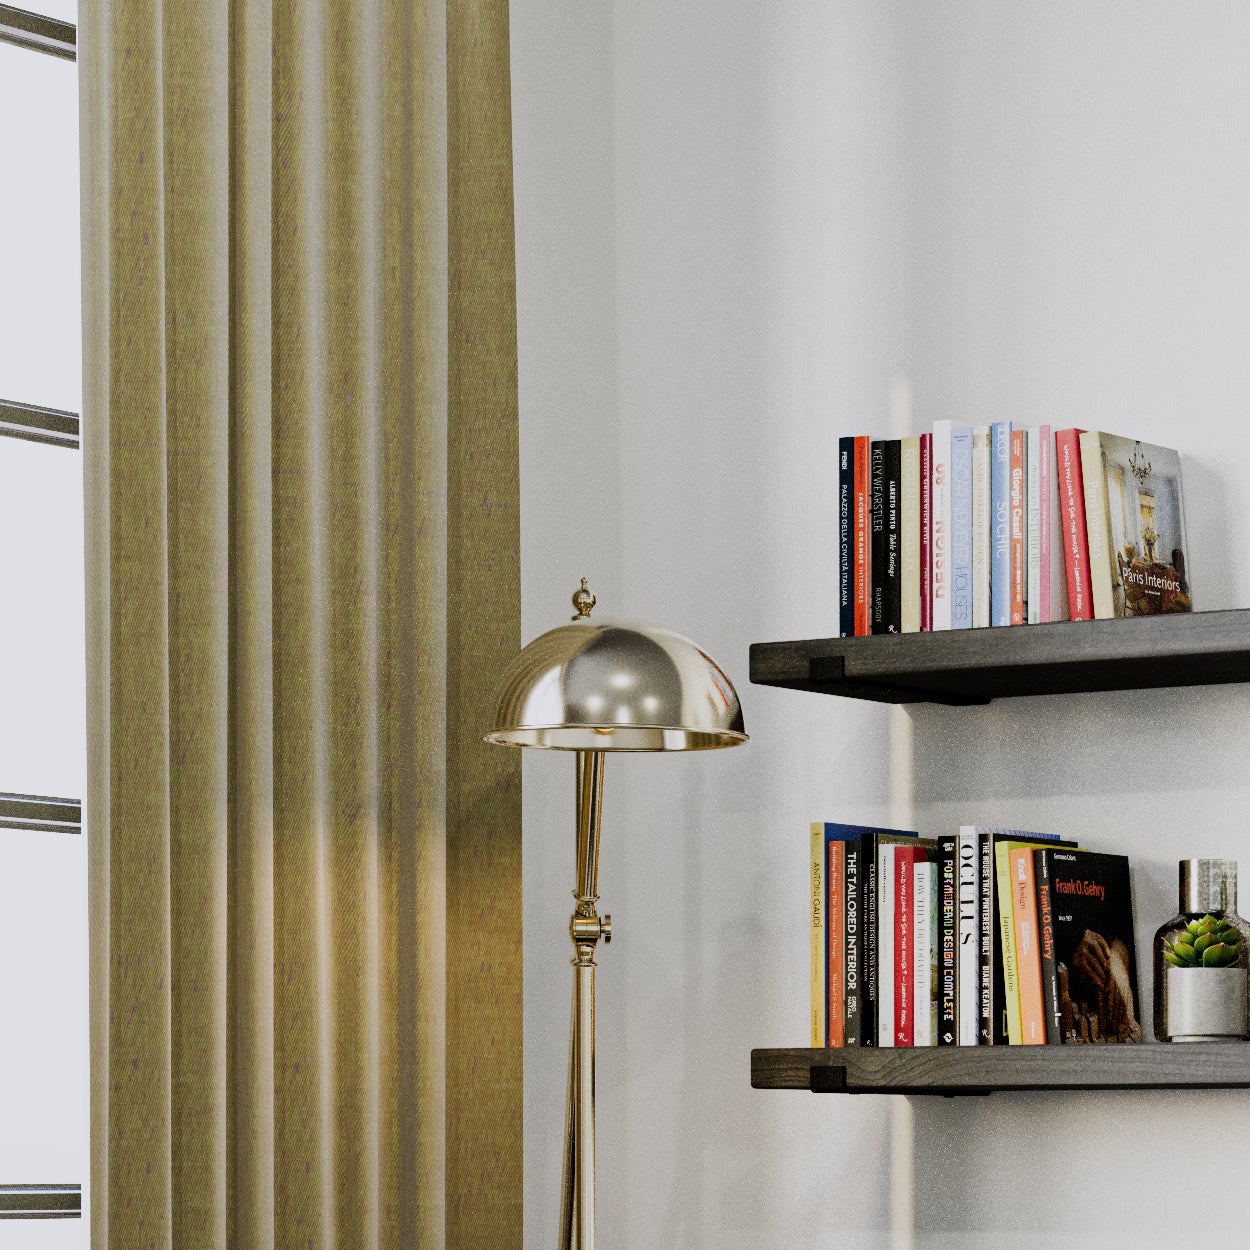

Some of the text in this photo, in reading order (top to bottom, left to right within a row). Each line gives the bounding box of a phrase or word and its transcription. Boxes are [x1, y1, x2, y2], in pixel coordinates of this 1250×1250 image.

[873, 449, 882, 532] KELLY WEARSTLER
[905, 448, 915, 517] REGENCY
[954, 447, 968, 497] OSCAR
[1011, 468, 1023, 506] Giorgio
[1063, 444, 1071, 468] WOULD
[1068, 497, 1074, 506] TO
[954, 500, 968, 565] NIEMEYER
[997, 501, 1009, 559] SO CHIC
[1012, 508, 1023, 539] Casali
[1088, 480, 1103, 559] Paris Interiors
[841, 543, 849, 571] CIVILTÀ
[905, 523, 915, 571] REDUX
[935, 520, 946, 599] DESIGN
[954, 567, 968, 621] HOUSES
[1122, 567, 1181, 592] Paris Interiors
[813, 862, 821, 897] ANTONI
[1017, 858, 1027, 881] Knoll
[1055, 877, 1077, 895] Frank
[1083, 880, 1105, 901] Gehry
[812, 898, 823, 928] GAUDÍ
[901, 914, 907, 922] TO
[917, 873, 925, 924] HOW THEY
[960, 844, 975, 945] OCULUS
[1018, 882, 1027, 910] Design
[1040, 885, 1052, 914] Frank
[847, 851, 857, 990] THE TAILORED INTERIOR
[900, 937, 908, 949] THE
[943, 859, 954, 1021] POSTMODERN DESIGN COMPLETE
[982, 841, 990, 1018] THE HOUSE THAT PINTEREST BUILT DIANE KEATON
[1042, 914, 1051, 926] O.
[1043, 926, 1055, 960] Gehry
[1002, 916, 1015, 992] Japanese Gardens
